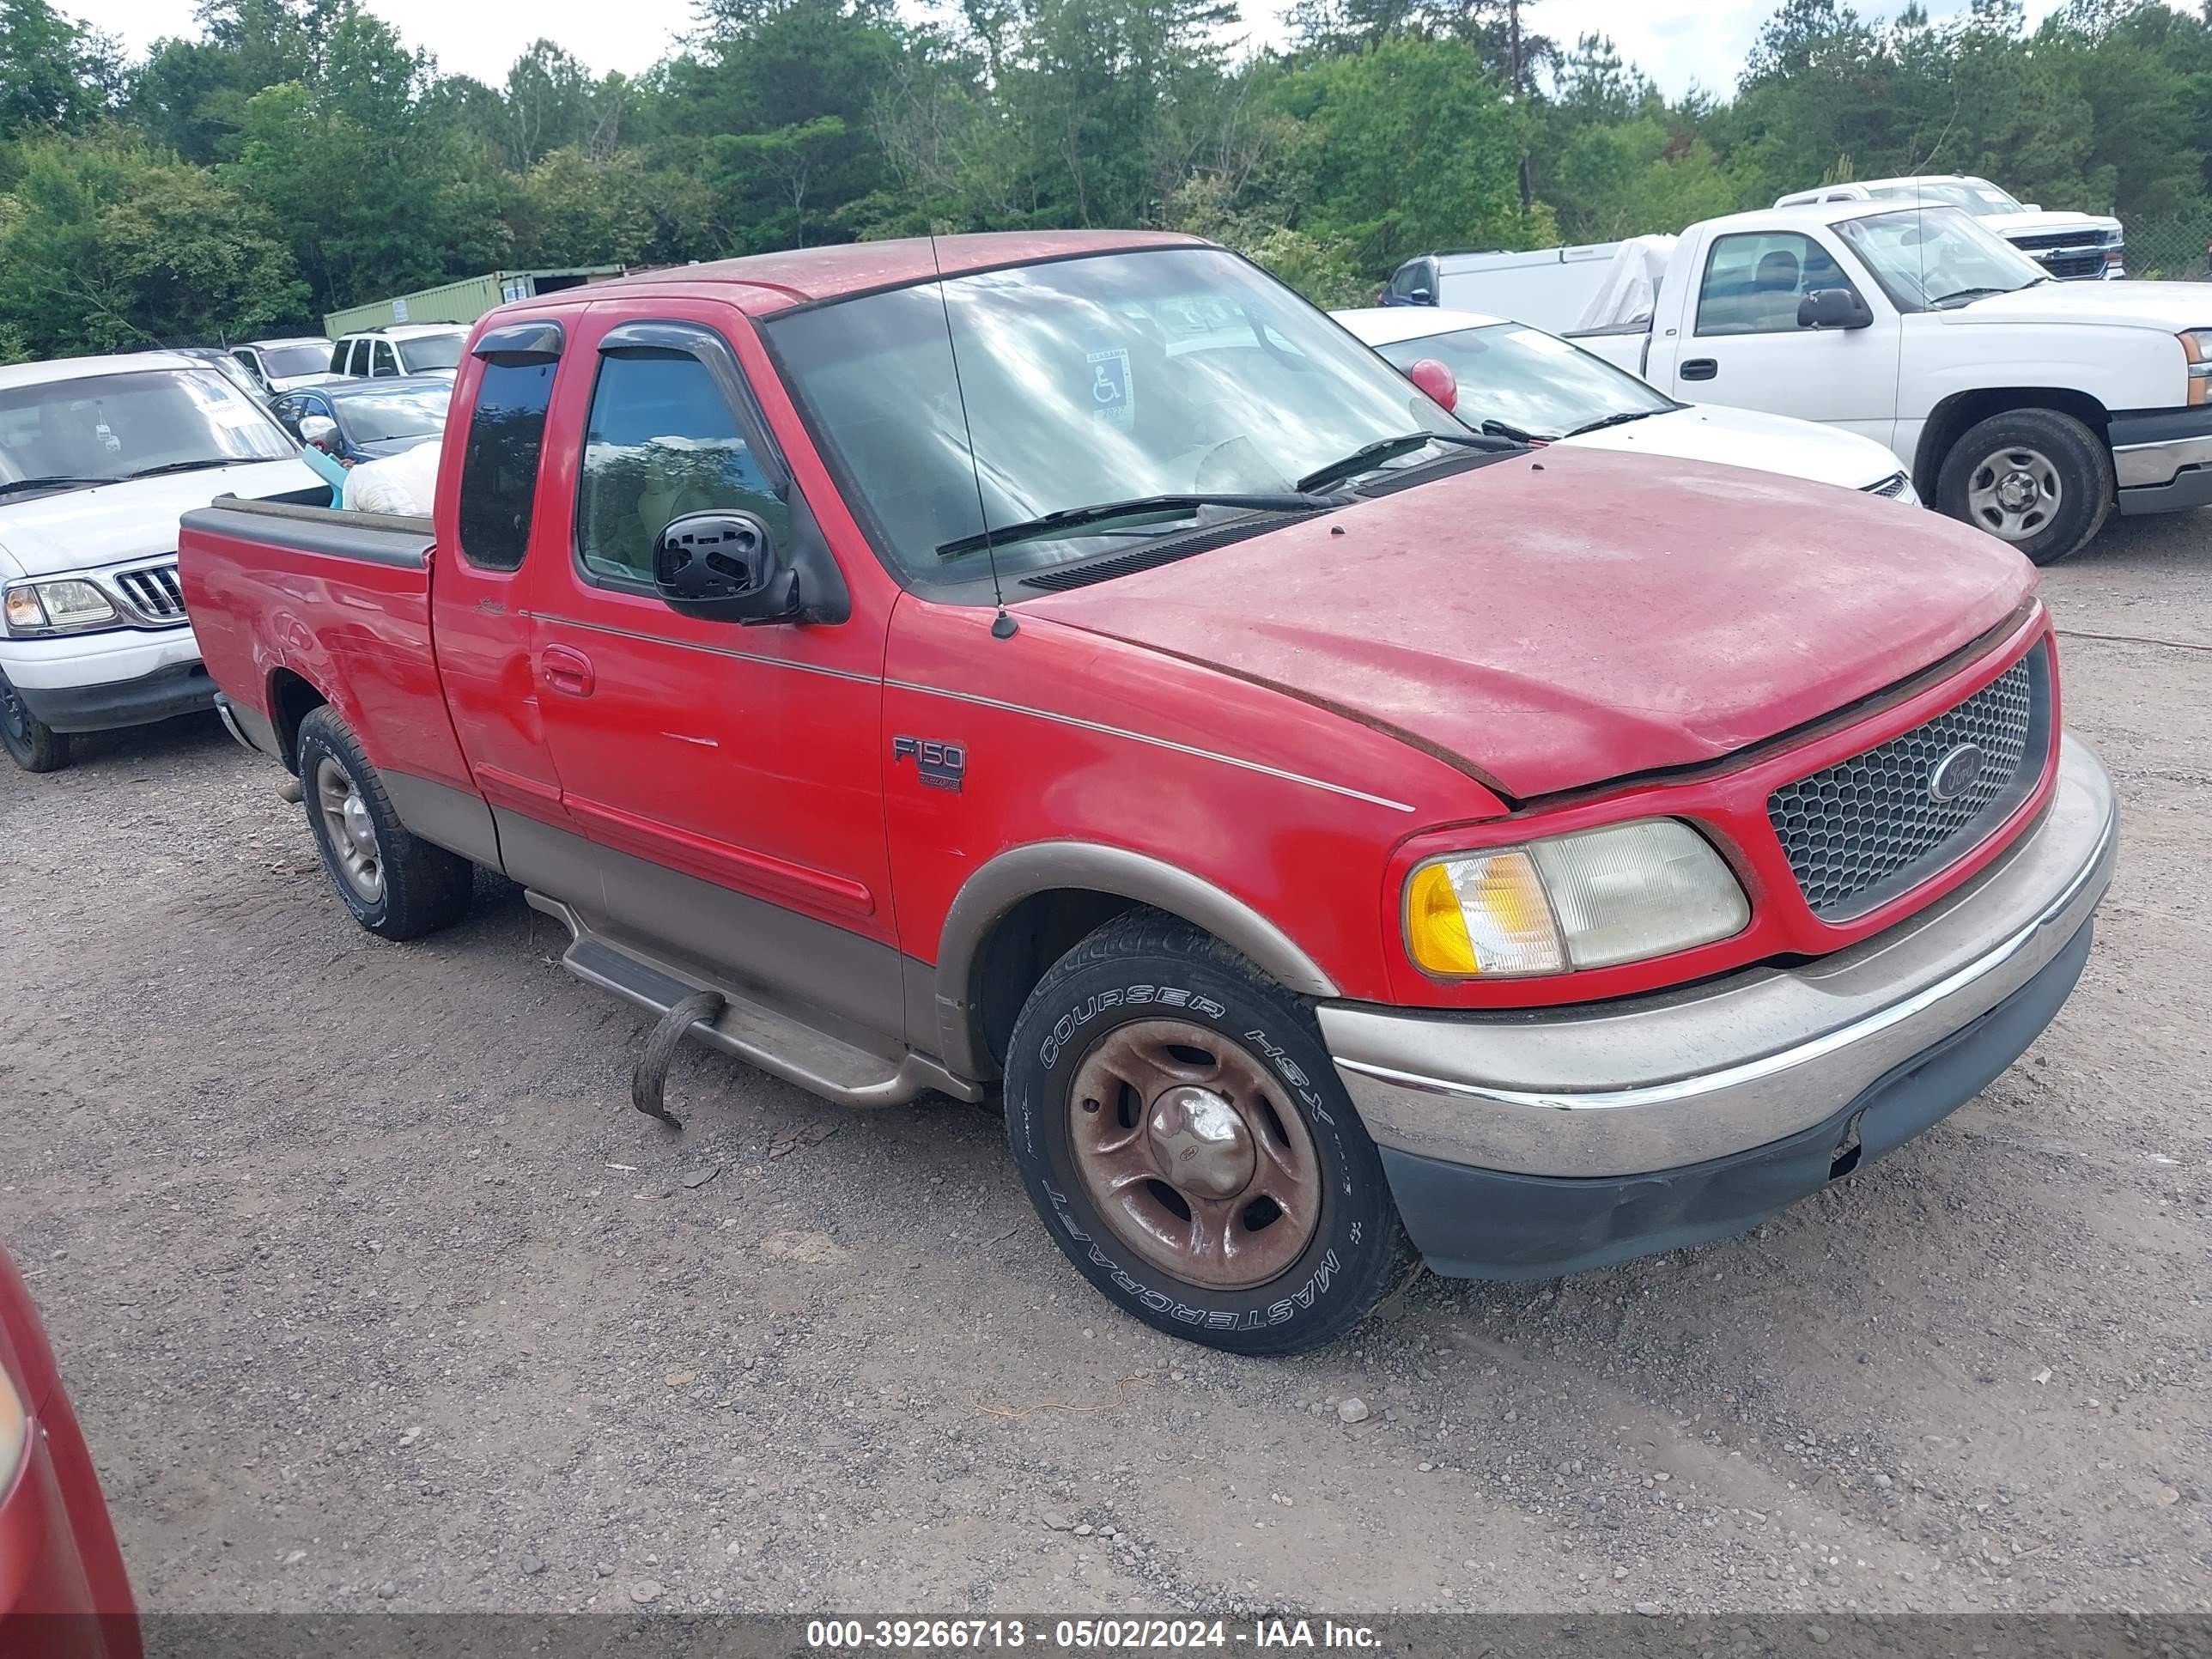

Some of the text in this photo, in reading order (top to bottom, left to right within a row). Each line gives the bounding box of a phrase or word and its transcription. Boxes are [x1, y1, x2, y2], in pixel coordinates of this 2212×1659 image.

[1948, 756, 1976, 791] Ford
[1038, 984, 1336, 1127] COURSER HSX
[1042, 1179, 1342, 1332] MASTERCRAFT
